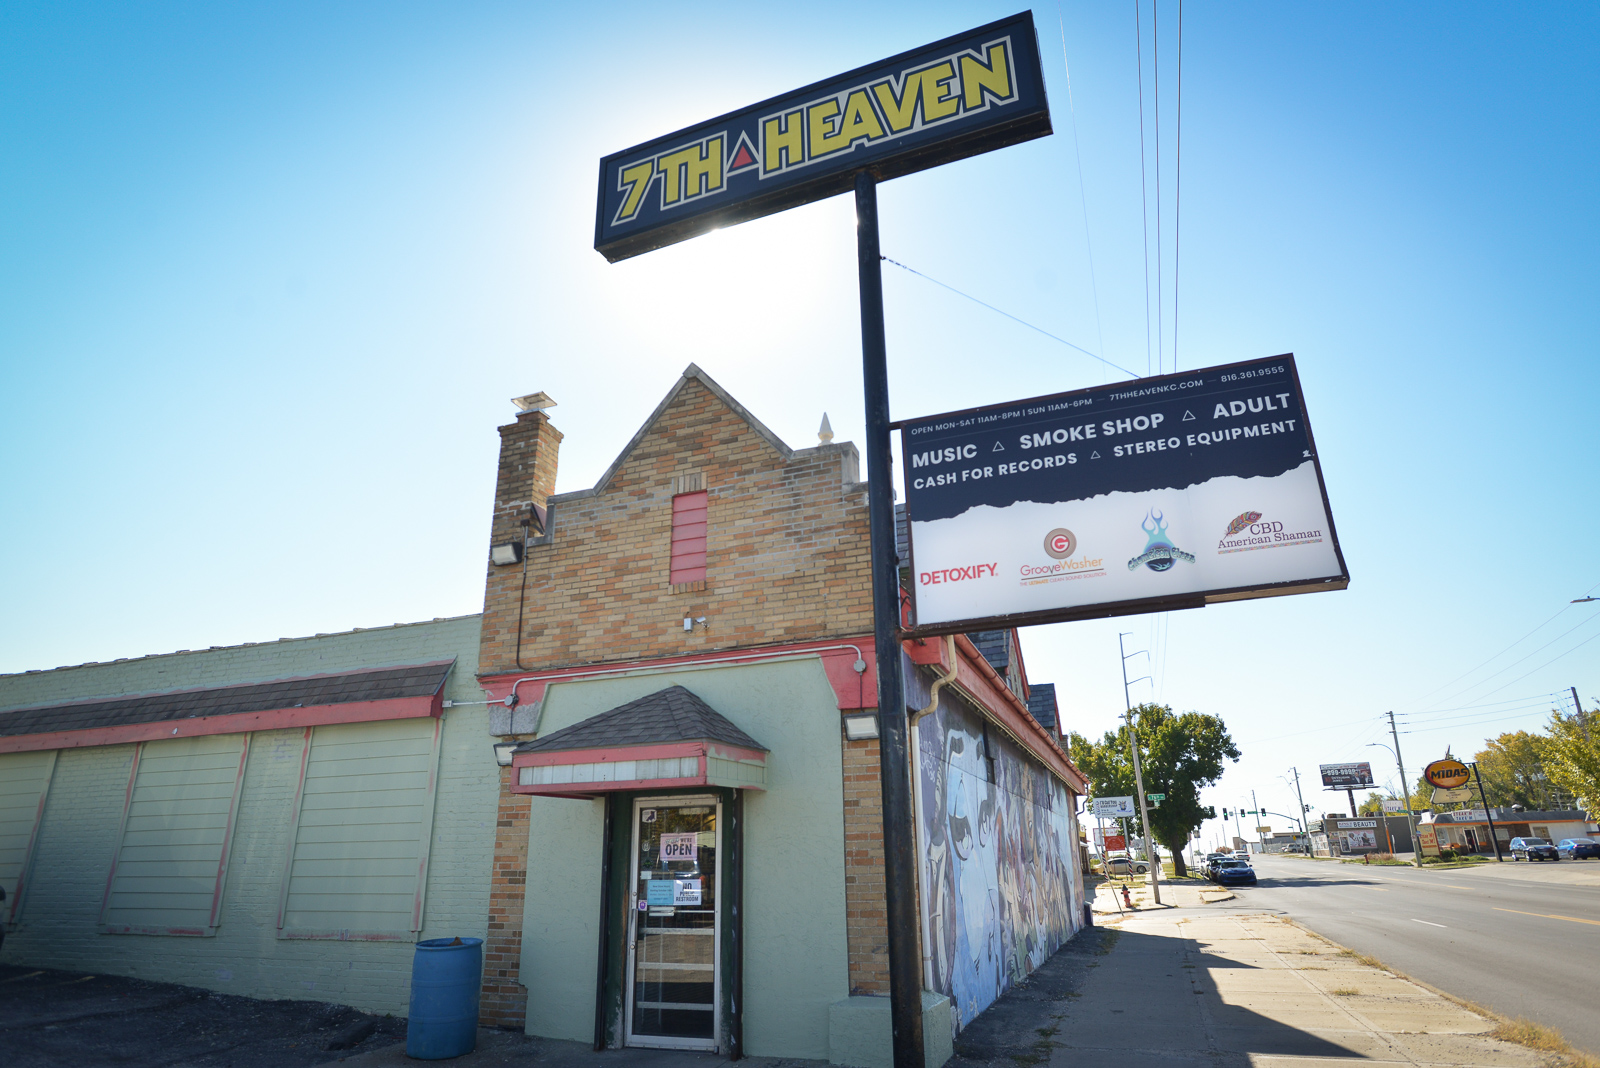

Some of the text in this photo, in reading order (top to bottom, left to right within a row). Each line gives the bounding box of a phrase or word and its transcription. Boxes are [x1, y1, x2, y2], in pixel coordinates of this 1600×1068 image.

[611, 36, 1019, 227] 7TH HEAVEN
[911, 365, 1285, 435] OPEN MON-SAT 11AM-8PM SUN 11AM-6PM 7THHEAVENKC.COM 816.361.9555
[912, 393, 1290, 468] MUSIC SMOKE SHOP ADULT
[913, 419, 1296, 490] CASH FOR RECORDS STEREO EQUIPMENT
[1249, 521, 1284, 536] CBD
[1217, 529, 1321, 549] American Shaman
[1020, 555, 1103, 576] GrooveWasher
[1431, 768, 1468, 780] MIDAS
[665, 843, 692, 856] OPEN
[682, 882, 692, 890] NO
